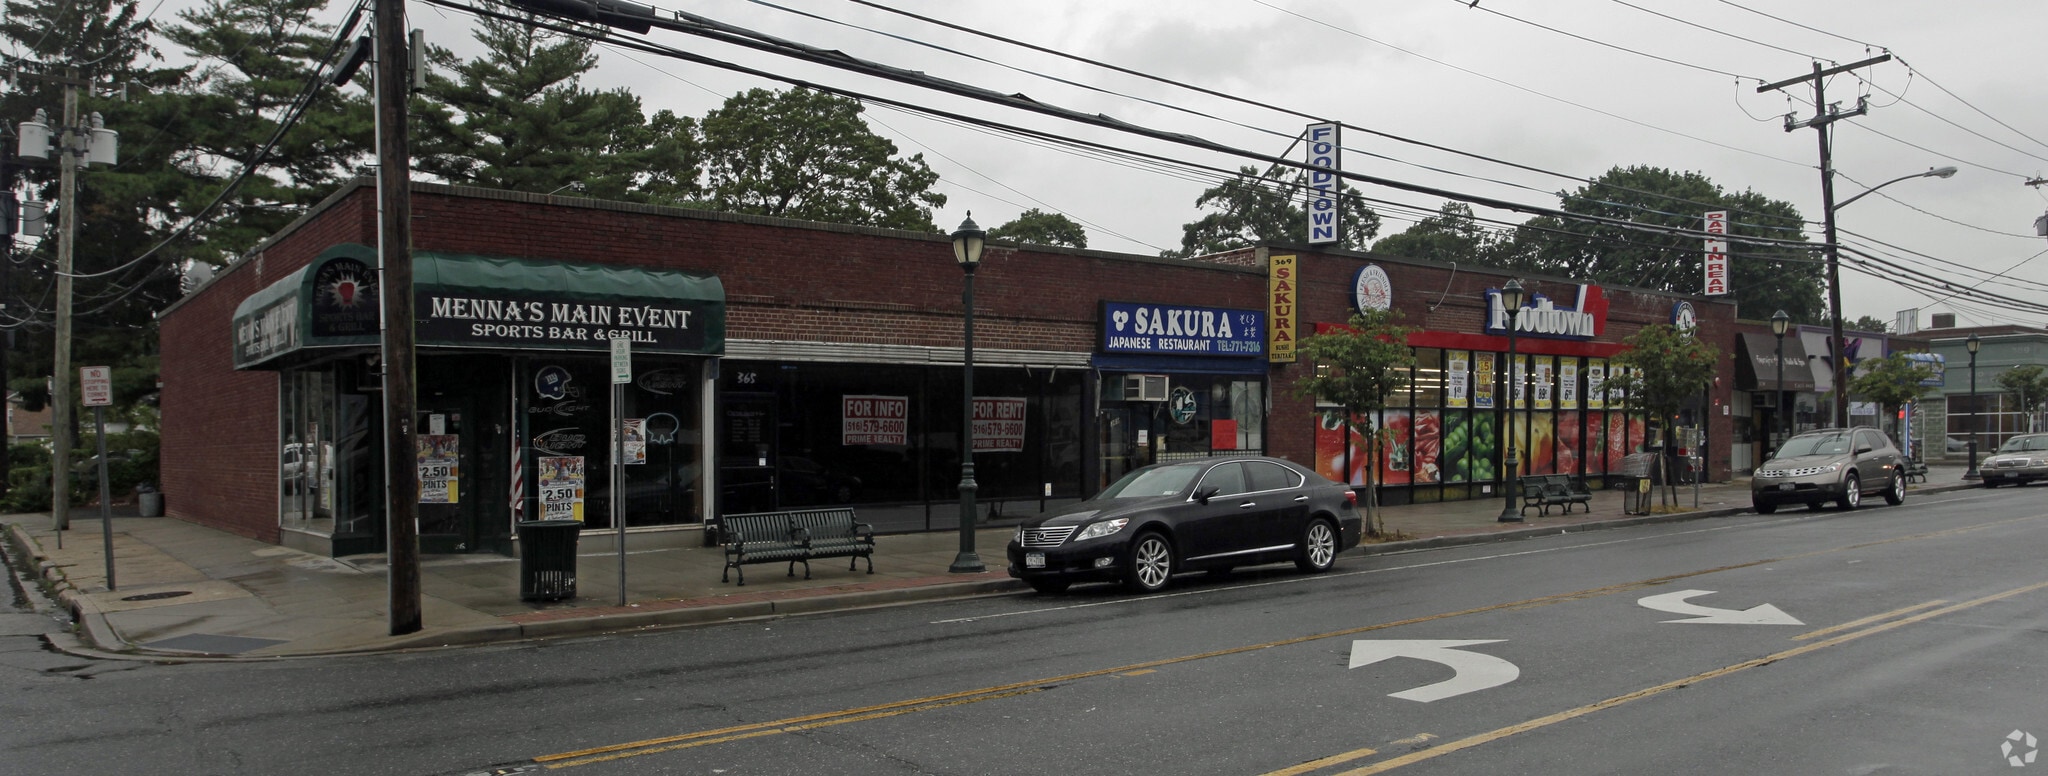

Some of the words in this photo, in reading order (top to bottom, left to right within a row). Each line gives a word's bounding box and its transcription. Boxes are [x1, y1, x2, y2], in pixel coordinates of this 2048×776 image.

[1312, 127, 1334, 240] FOODTOWN
[1708, 264, 1724, 293] REAR
[430, 296, 545, 323] MENNA'S
[551, 303, 611, 325] MAIN
[618, 305, 692, 330] EVENT
[1274, 267, 1292, 342] SAKURA
[1134, 307, 1233, 338] SAKURA
[471, 322, 544, 337] SPORTS
[548, 327, 588, 341] BAR
[594, 329, 606, 341] &
[607, 330, 658, 343] GRILL
[1108, 337, 1151, 350] JAPANESE
[1158, 340, 1211, 352] RESTAURANT
[737, 372, 757, 384] 365
[846, 400, 871, 417] FOR
[874, 400, 905, 417] INFO
[972, 402, 994, 418] FOR
[996, 402, 1023, 419] RENT
[847, 435, 871, 444] PRIME
[874, 435, 903, 444] REALTY
[972, 439, 993, 448] PRIME
[996, 439, 1022, 448] REALTY
[422, 480, 447, 489] PINTS
[543, 489, 572, 500] $2.50
[547, 503, 572, 512] PINTS
